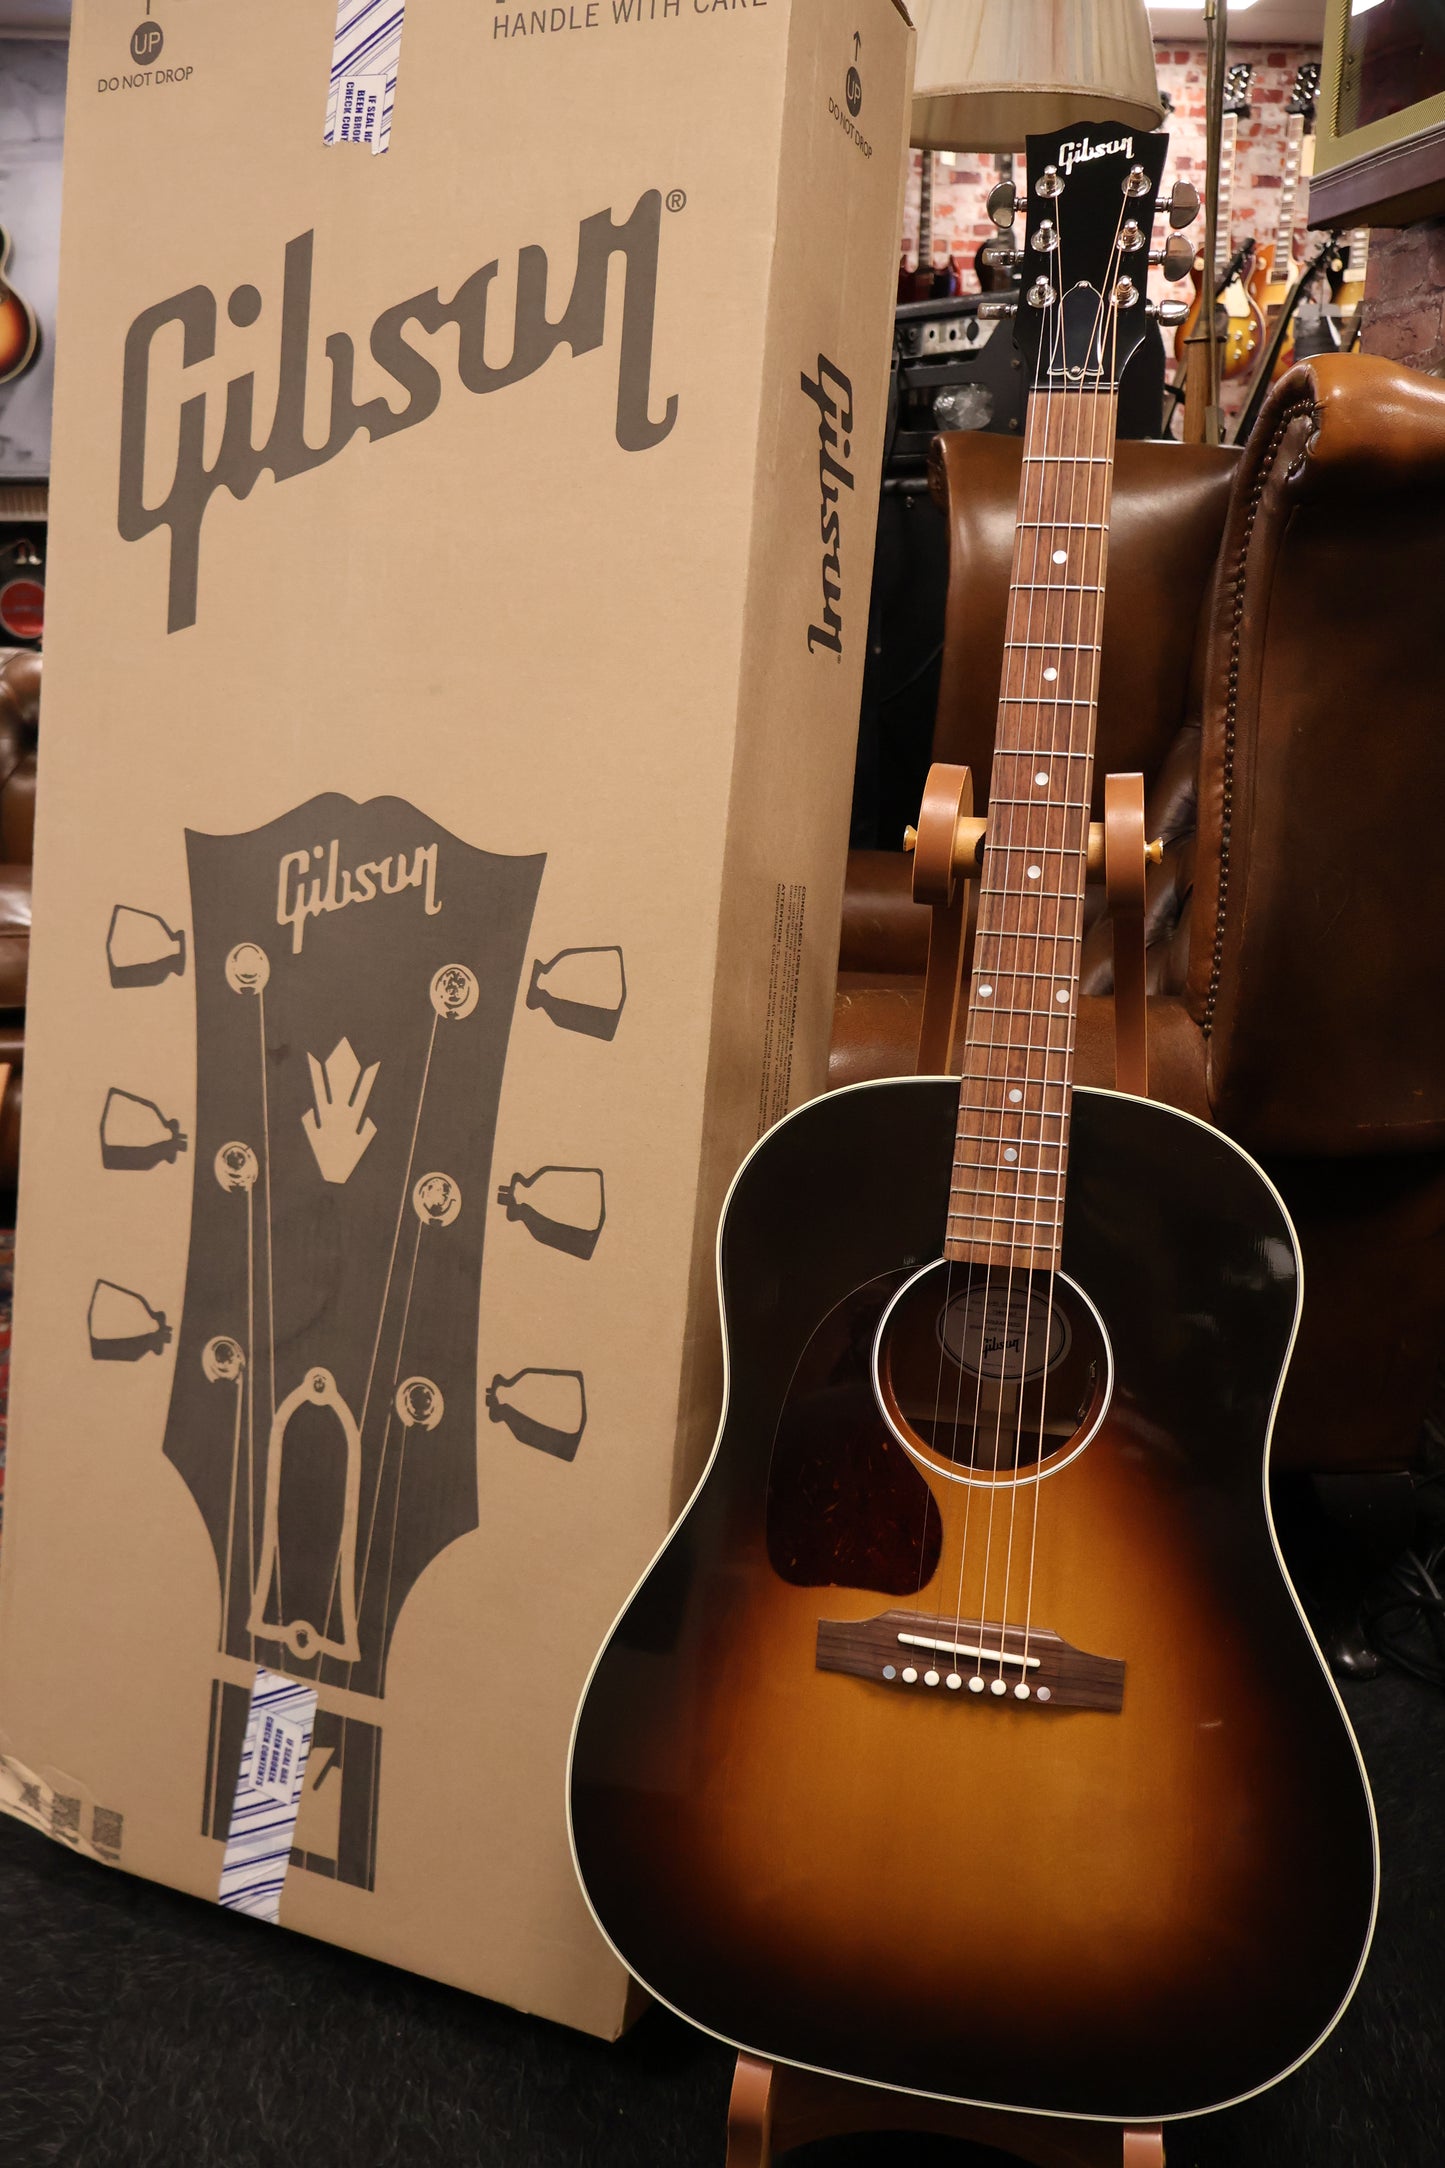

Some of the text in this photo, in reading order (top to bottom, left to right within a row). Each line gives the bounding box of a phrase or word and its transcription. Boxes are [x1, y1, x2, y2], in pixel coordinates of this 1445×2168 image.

[493, 3, 599, 39] HANDLE
[135, 32, 161, 55] UP
[97, 66, 193, 93] DO NOT DROP
[847, 75, 860, 105] UP
[341, 82, 354, 141] CHECK CONT
[355, 90, 365, 113] BEEN
[366, 107, 375, 128] SEAL
[369, 96, 376, 104] IF
[828, 97, 873, 159] DO NOT DROP
[1058, 136, 1135, 175] Gibson
[117, 188, 679, 635] Gibson
[801, 353, 855, 655] Gibson
[276, 839, 443, 955] Gibson
